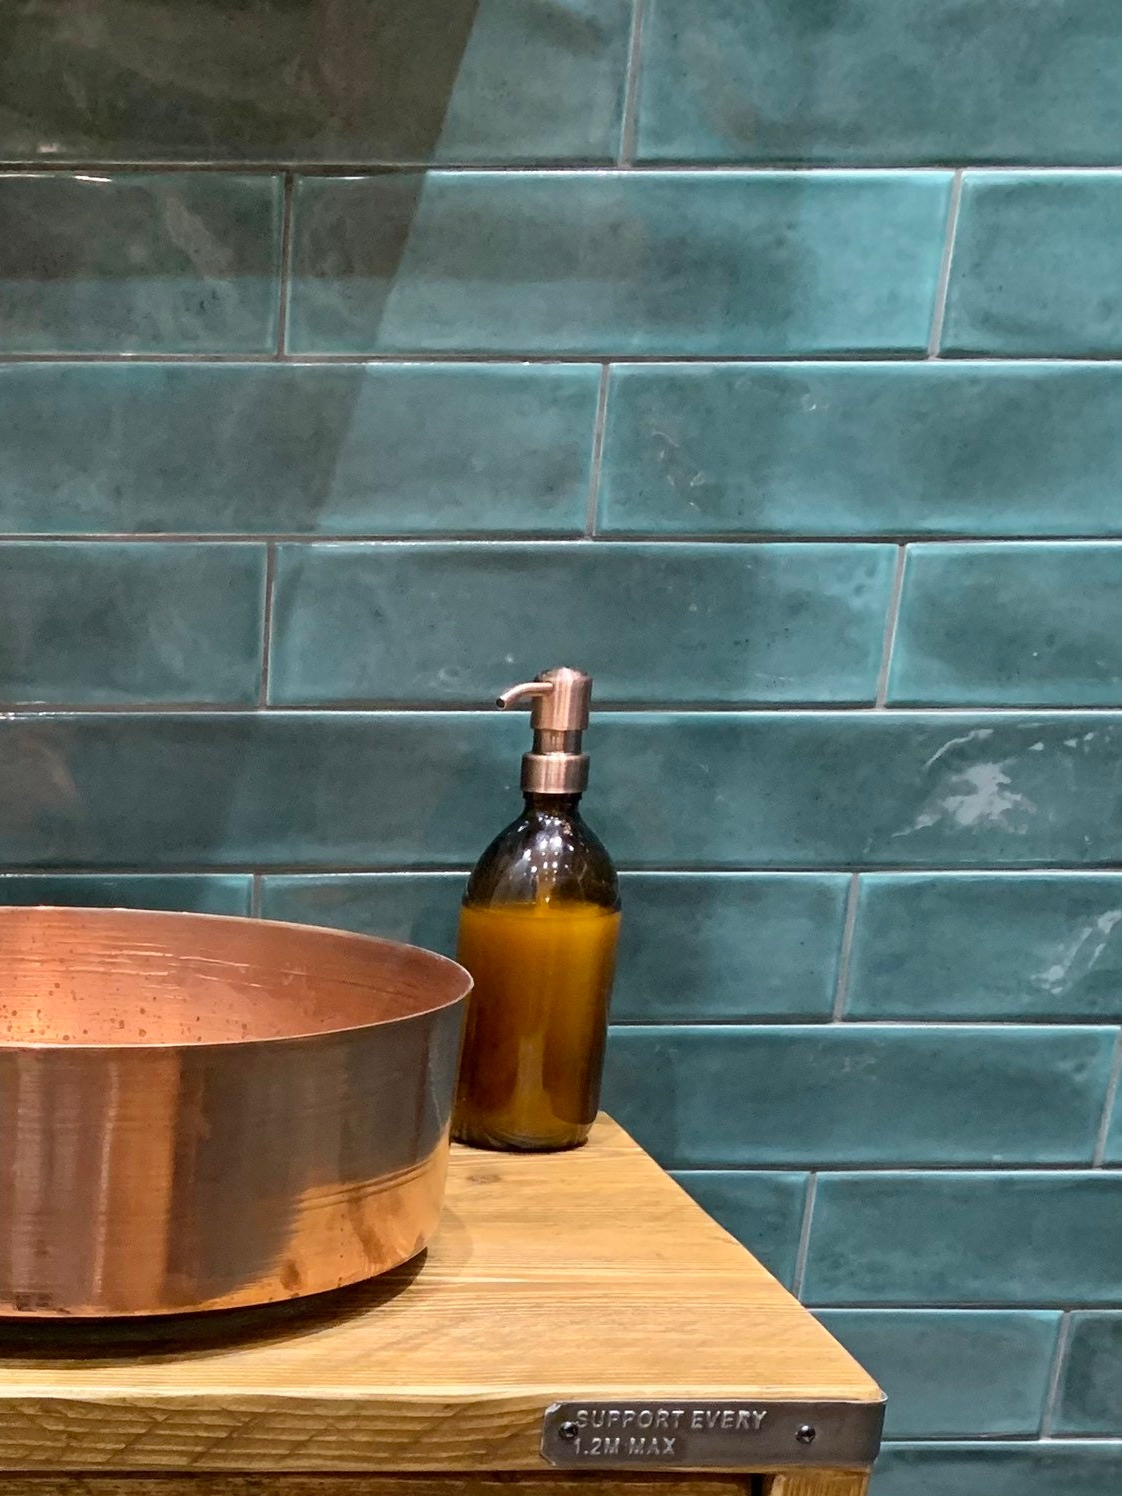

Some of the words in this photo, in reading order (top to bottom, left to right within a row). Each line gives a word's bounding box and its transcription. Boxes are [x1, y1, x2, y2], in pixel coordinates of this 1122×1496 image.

[575, 1409, 684, 1429] SUPPORT
[690, 1410, 767, 1430] EVERY
[572, 1437, 621, 1456] 1.2M
[628, 1437, 677, 1456] MAX
